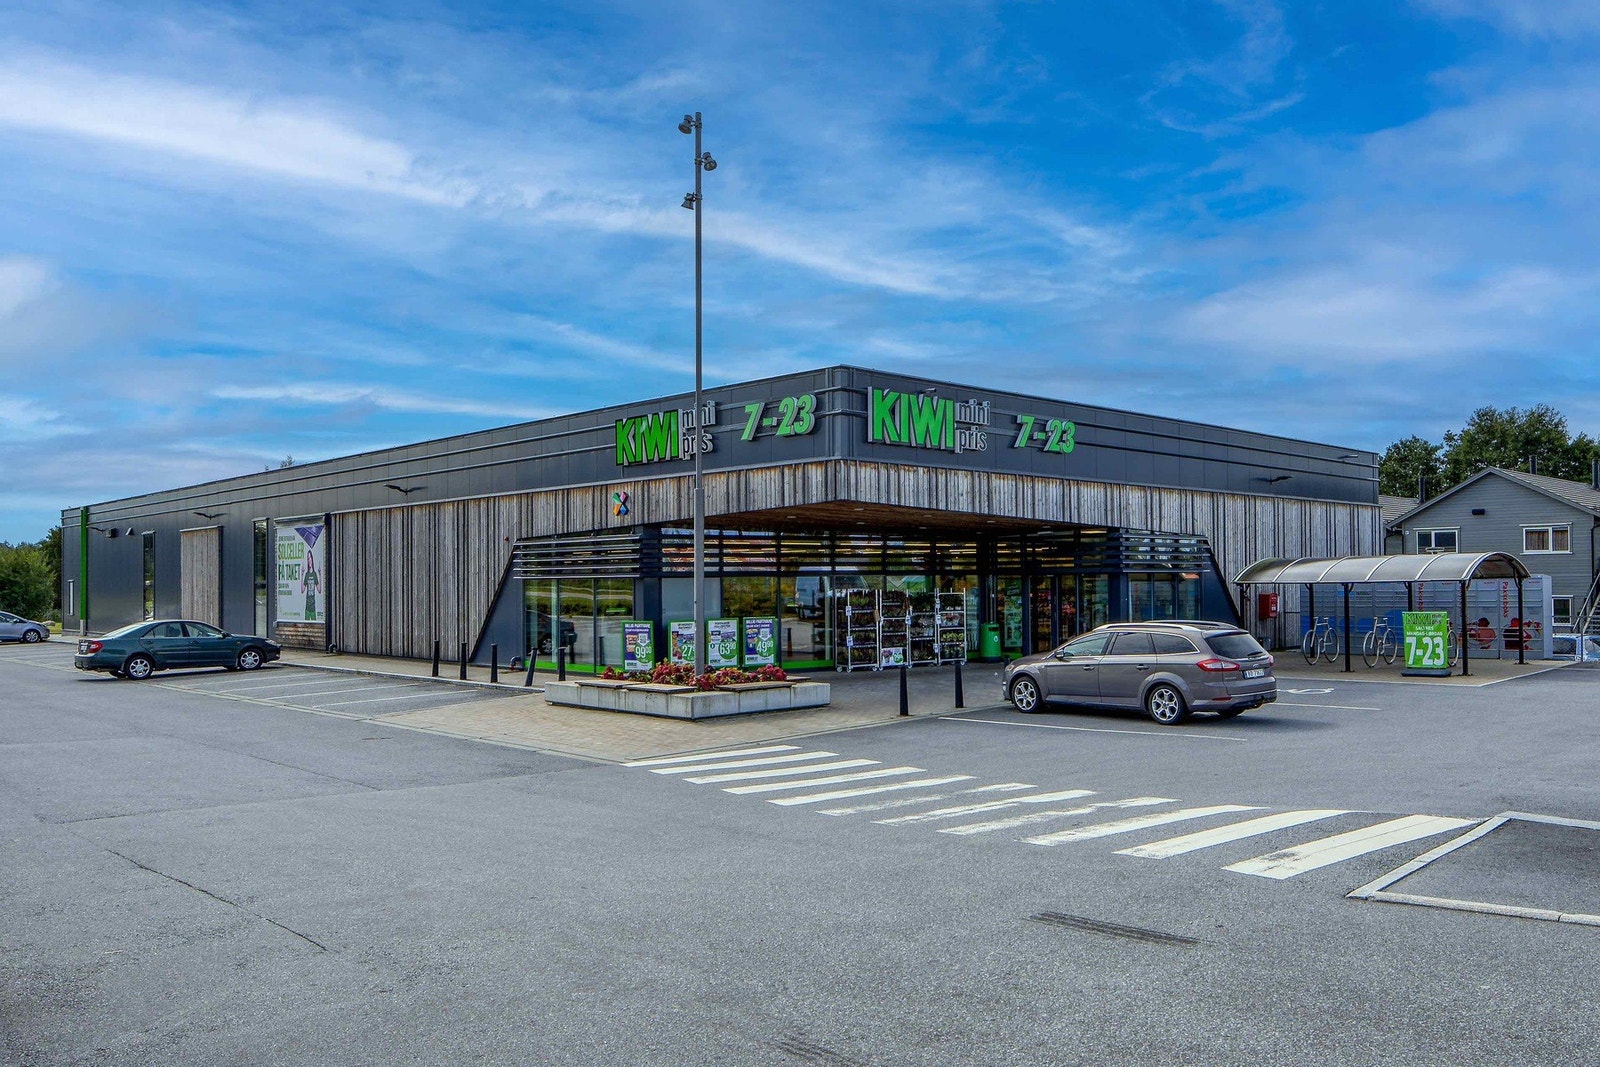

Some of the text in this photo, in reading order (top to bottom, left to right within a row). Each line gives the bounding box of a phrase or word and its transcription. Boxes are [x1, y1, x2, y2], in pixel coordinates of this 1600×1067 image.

[682, 400, 716, 429] mni
[740, 393, 817, 441] 7-23
[867, 386, 956, 450] KIWI
[956, 399, 991, 425] mini
[615, 409, 682, 466] KIWI
[682, 429, 713, 460] prs
[955, 426, 988, 453] pris
[1014, 414, 1077, 454] 7-23
[278, 542, 305, 560] SOLCELLER
[278, 561, 301, 581] PÅ TAKET
[1406, 613, 1431, 624] KIWI
[1405, 636, 1445, 666] 7-23
